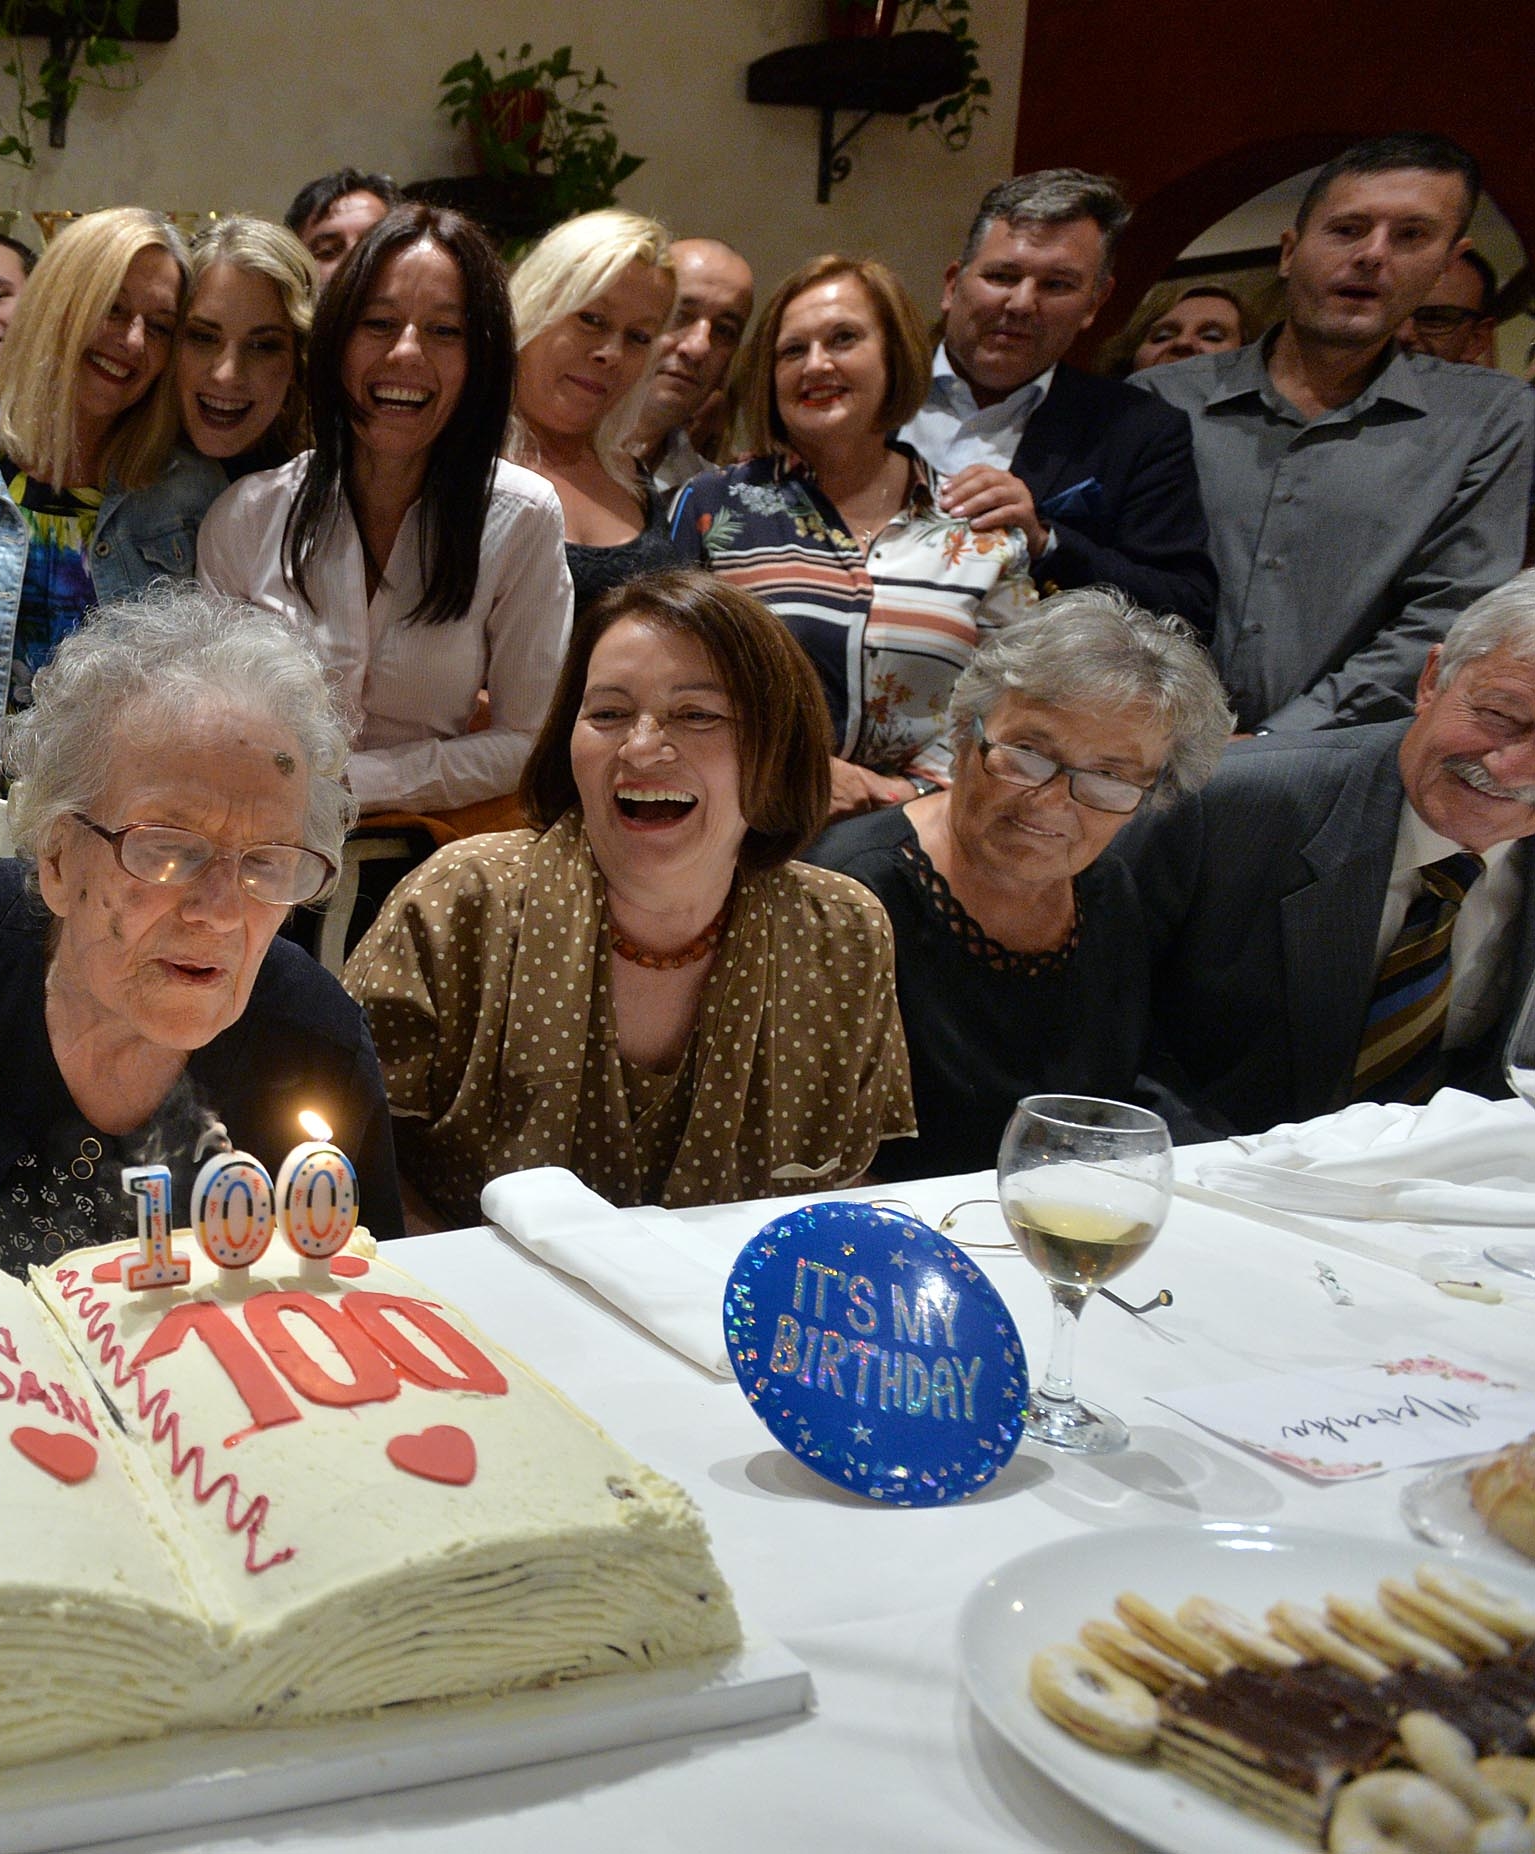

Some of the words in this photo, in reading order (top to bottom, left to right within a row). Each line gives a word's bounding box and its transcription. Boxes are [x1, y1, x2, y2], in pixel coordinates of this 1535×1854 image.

[121, 1141, 359, 1291] 100
[129, 1291, 508, 1430] 100
[793, 1257, 877, 1336] IT'S
[892, 1283, 960, 1347] MY
[770, 1314, 983, 1421] BIRTHDAY
